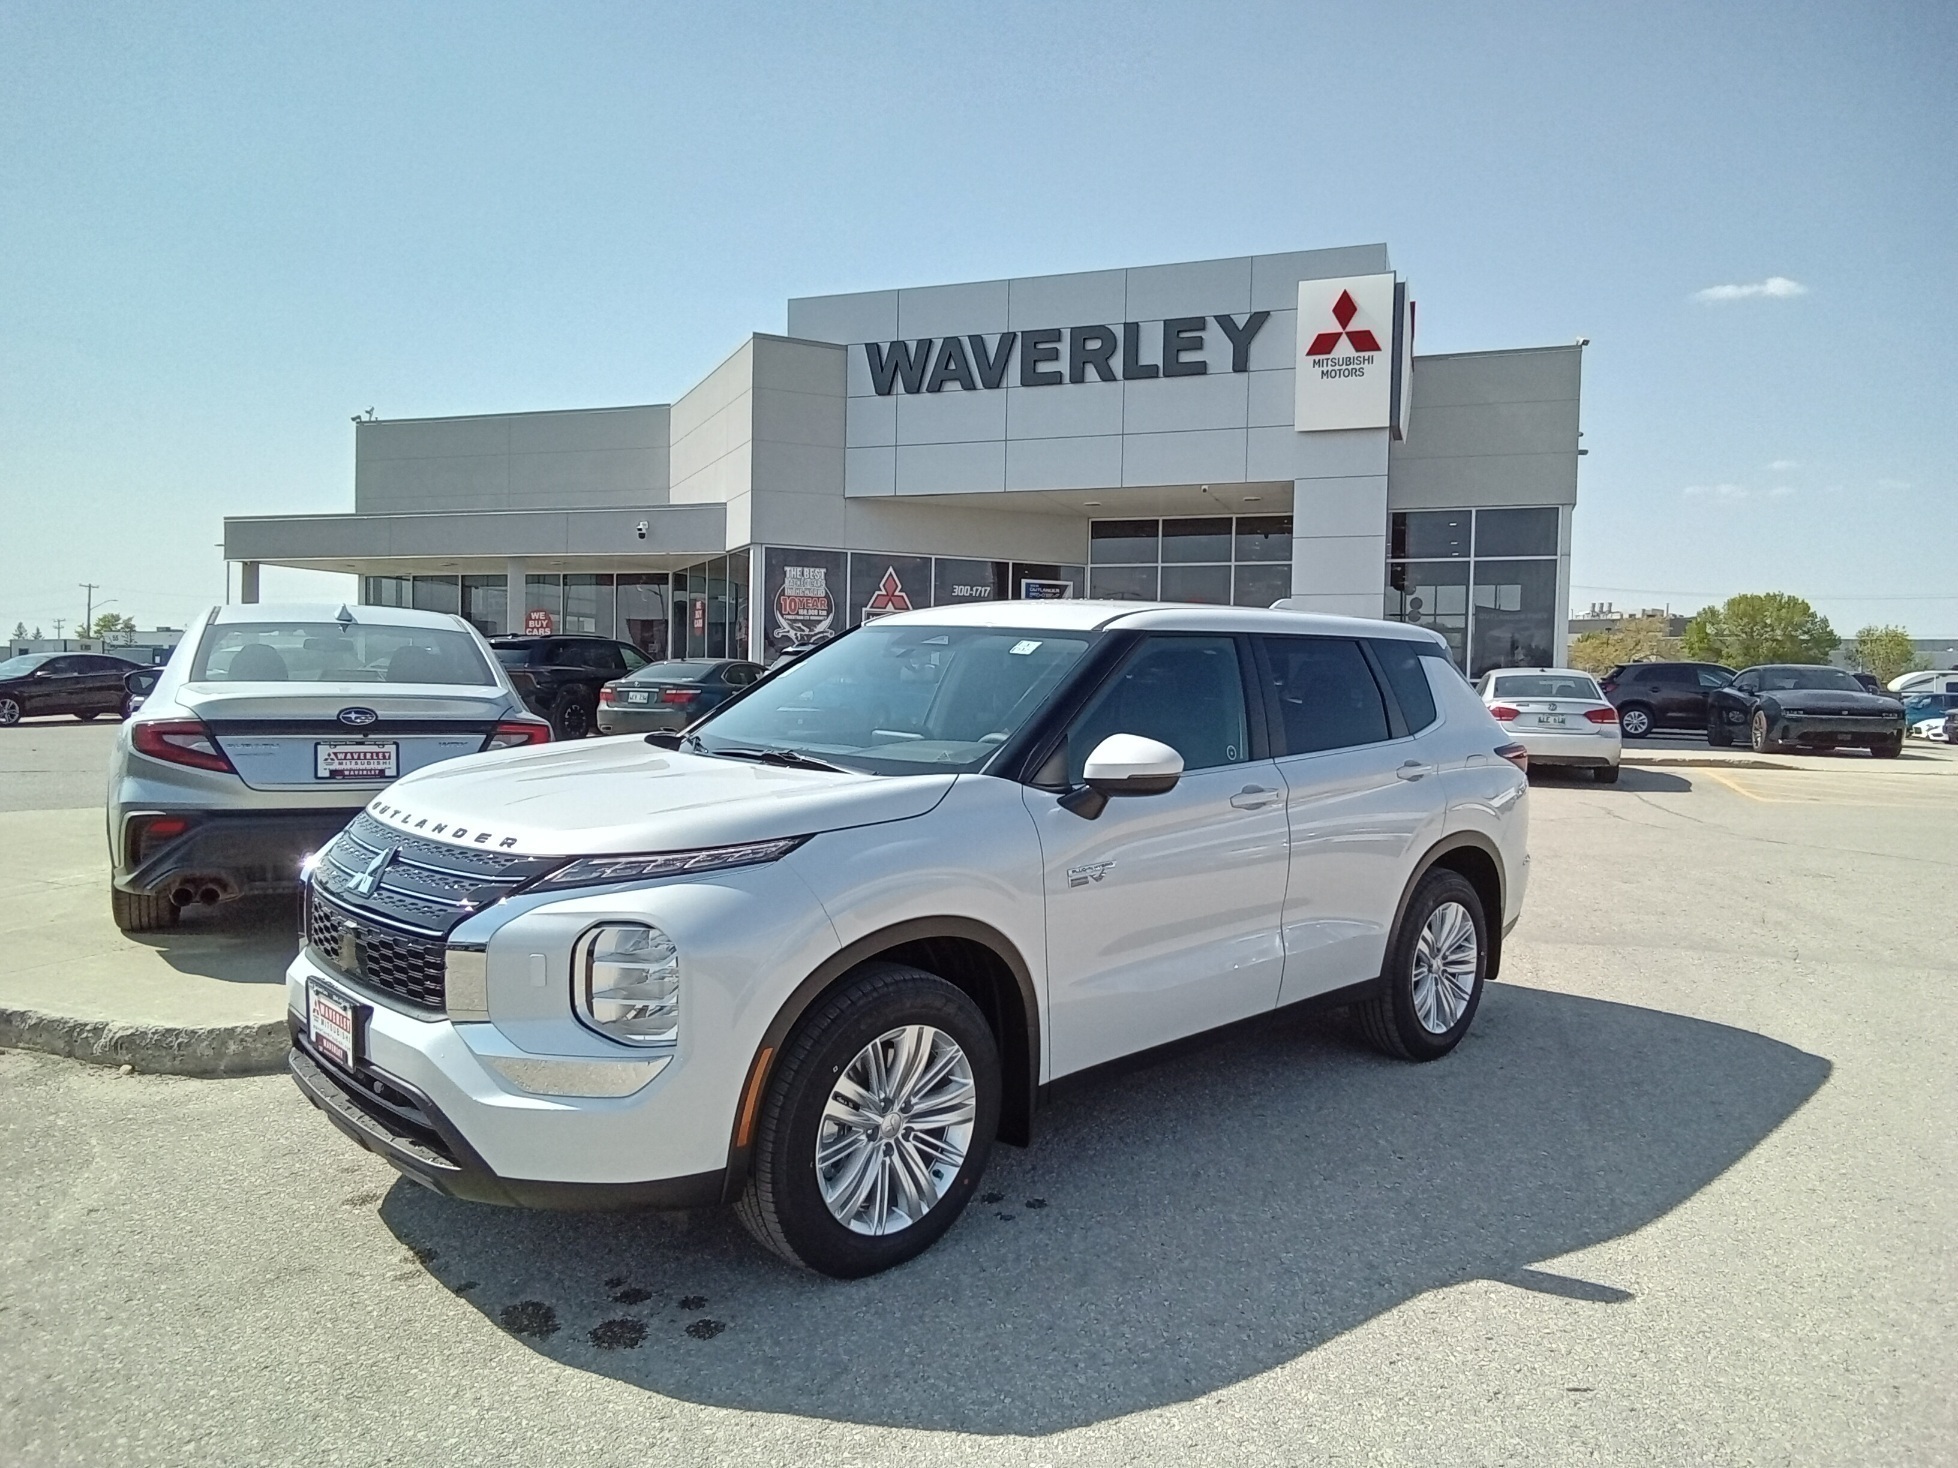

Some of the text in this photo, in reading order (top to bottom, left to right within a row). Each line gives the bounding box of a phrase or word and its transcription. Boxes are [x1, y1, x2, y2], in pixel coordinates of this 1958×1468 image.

[865, 311, 1271, 396] WAVERLEY
[1312, 354, 1375, 369] MITSUBISHI
[1320, 366, 1366, 380] MOTORS
[784, 567, 827, 579] THE BEST
[952, 585, 991, 597] 300-1717
[781, 596, 828, 614] 10 YEAR
[528, 620, 548, 628] BUY
[526, 627, 551, 636] CARS
[337, 752, 391, 760] WAVERLEY
[371, 800, 518, 849] OUTLANDER
[319, 1002, 351, 1034] WAVERLEY
[320, 1018, 351, 1044] MITSUBISHI
